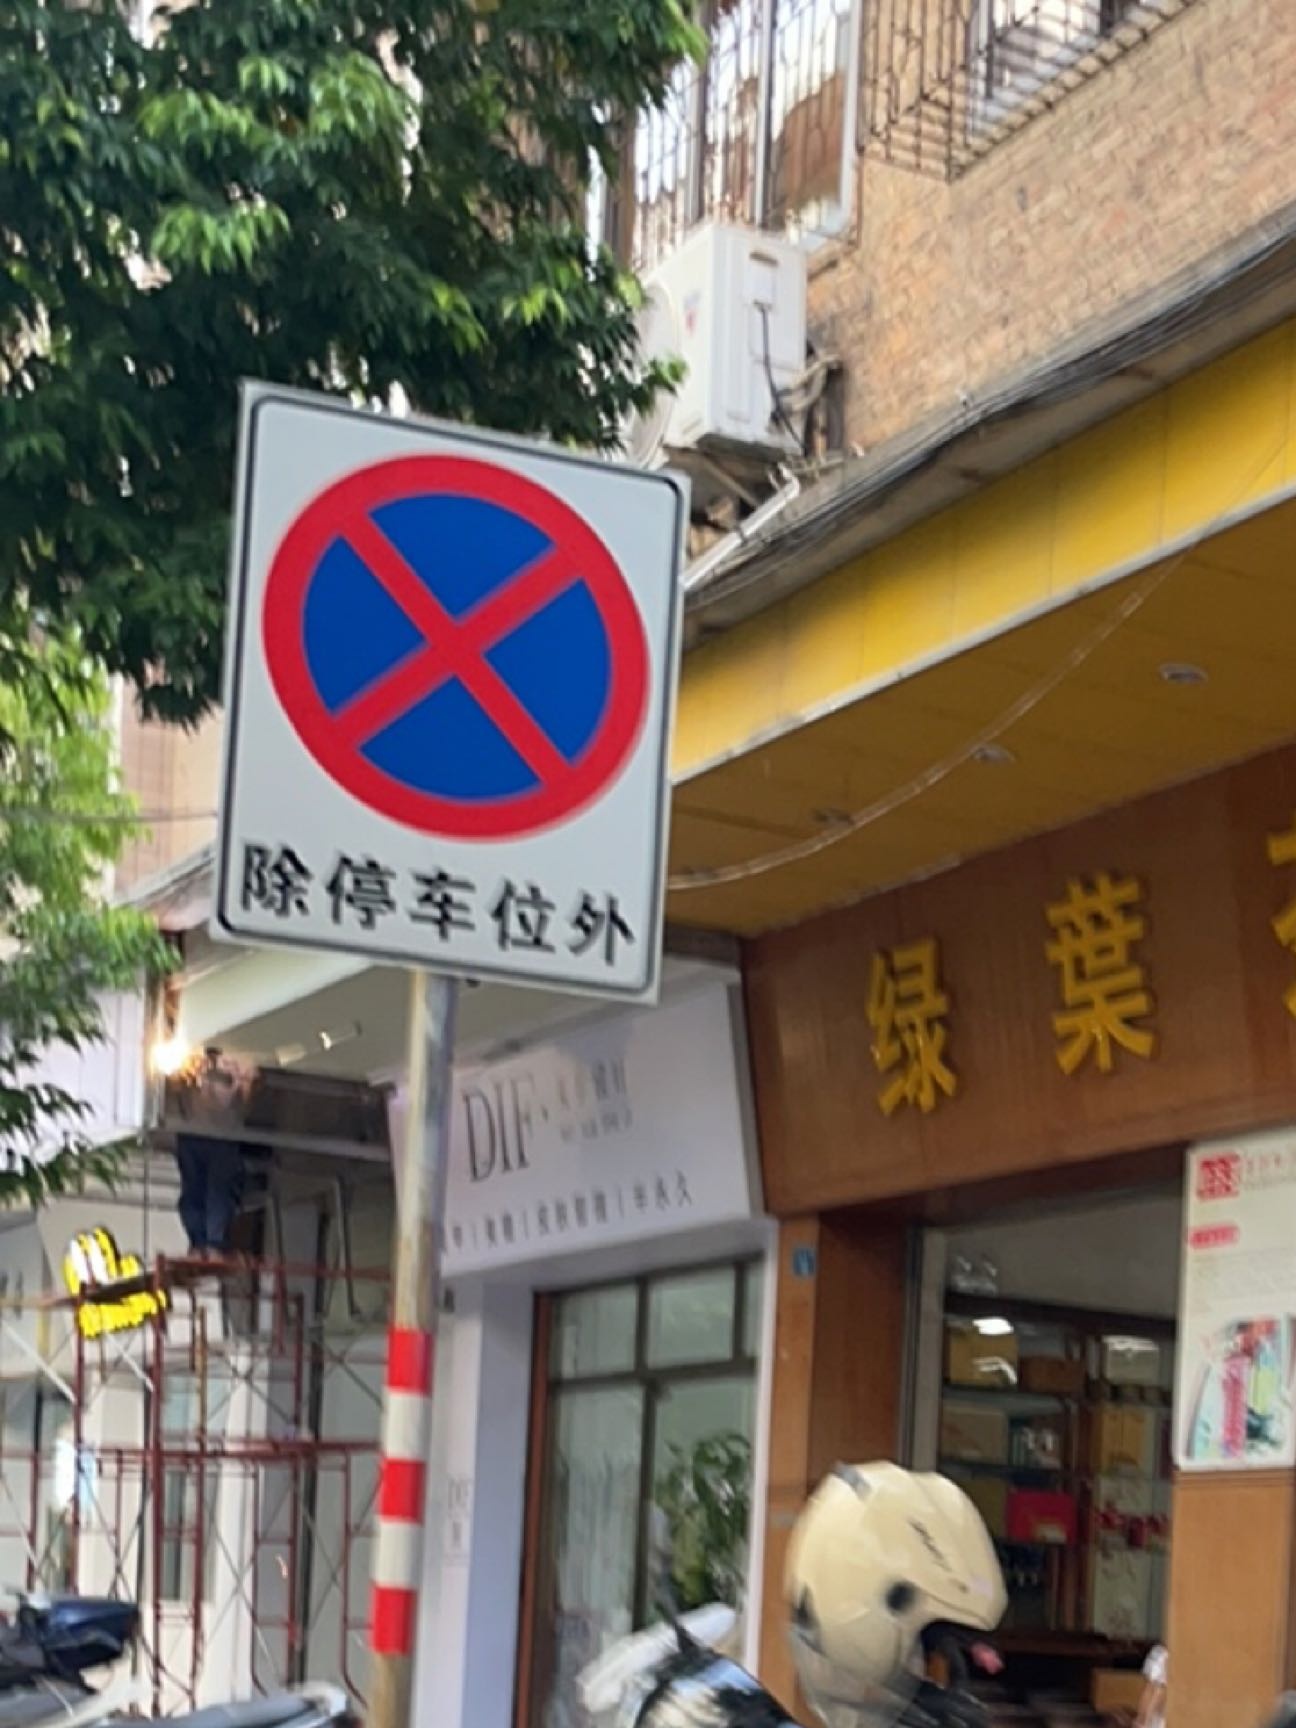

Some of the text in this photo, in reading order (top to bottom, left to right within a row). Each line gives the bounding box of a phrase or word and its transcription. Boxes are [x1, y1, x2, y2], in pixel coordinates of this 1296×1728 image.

[241, 842, 636, 967] 除停车位外
